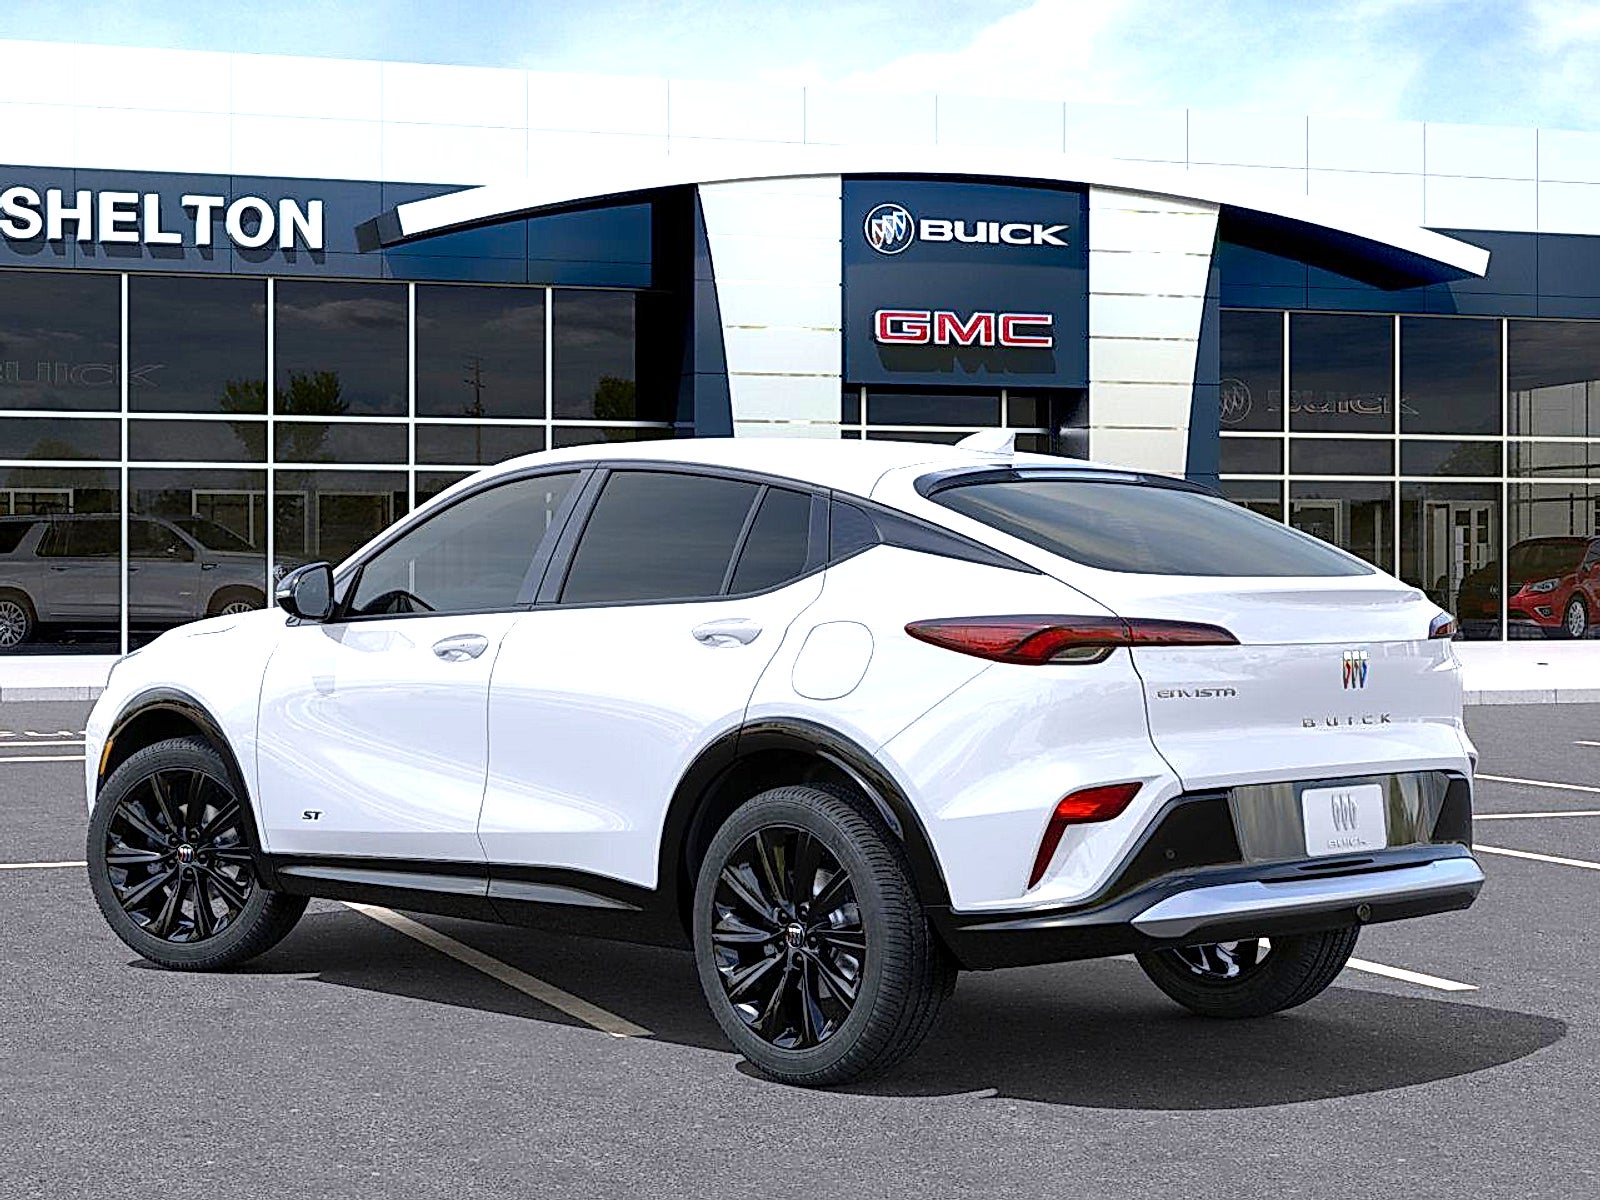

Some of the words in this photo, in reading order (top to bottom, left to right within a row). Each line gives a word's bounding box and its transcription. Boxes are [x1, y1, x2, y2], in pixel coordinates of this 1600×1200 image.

[0, 186, 323, 249] SHELTON
[919, 218, 1070, 246] BUICK
[874, 309, 1053, 348] GMC
[1303, 713, 1391, 727] BUICK
[302, 810, 323, 820] ST
